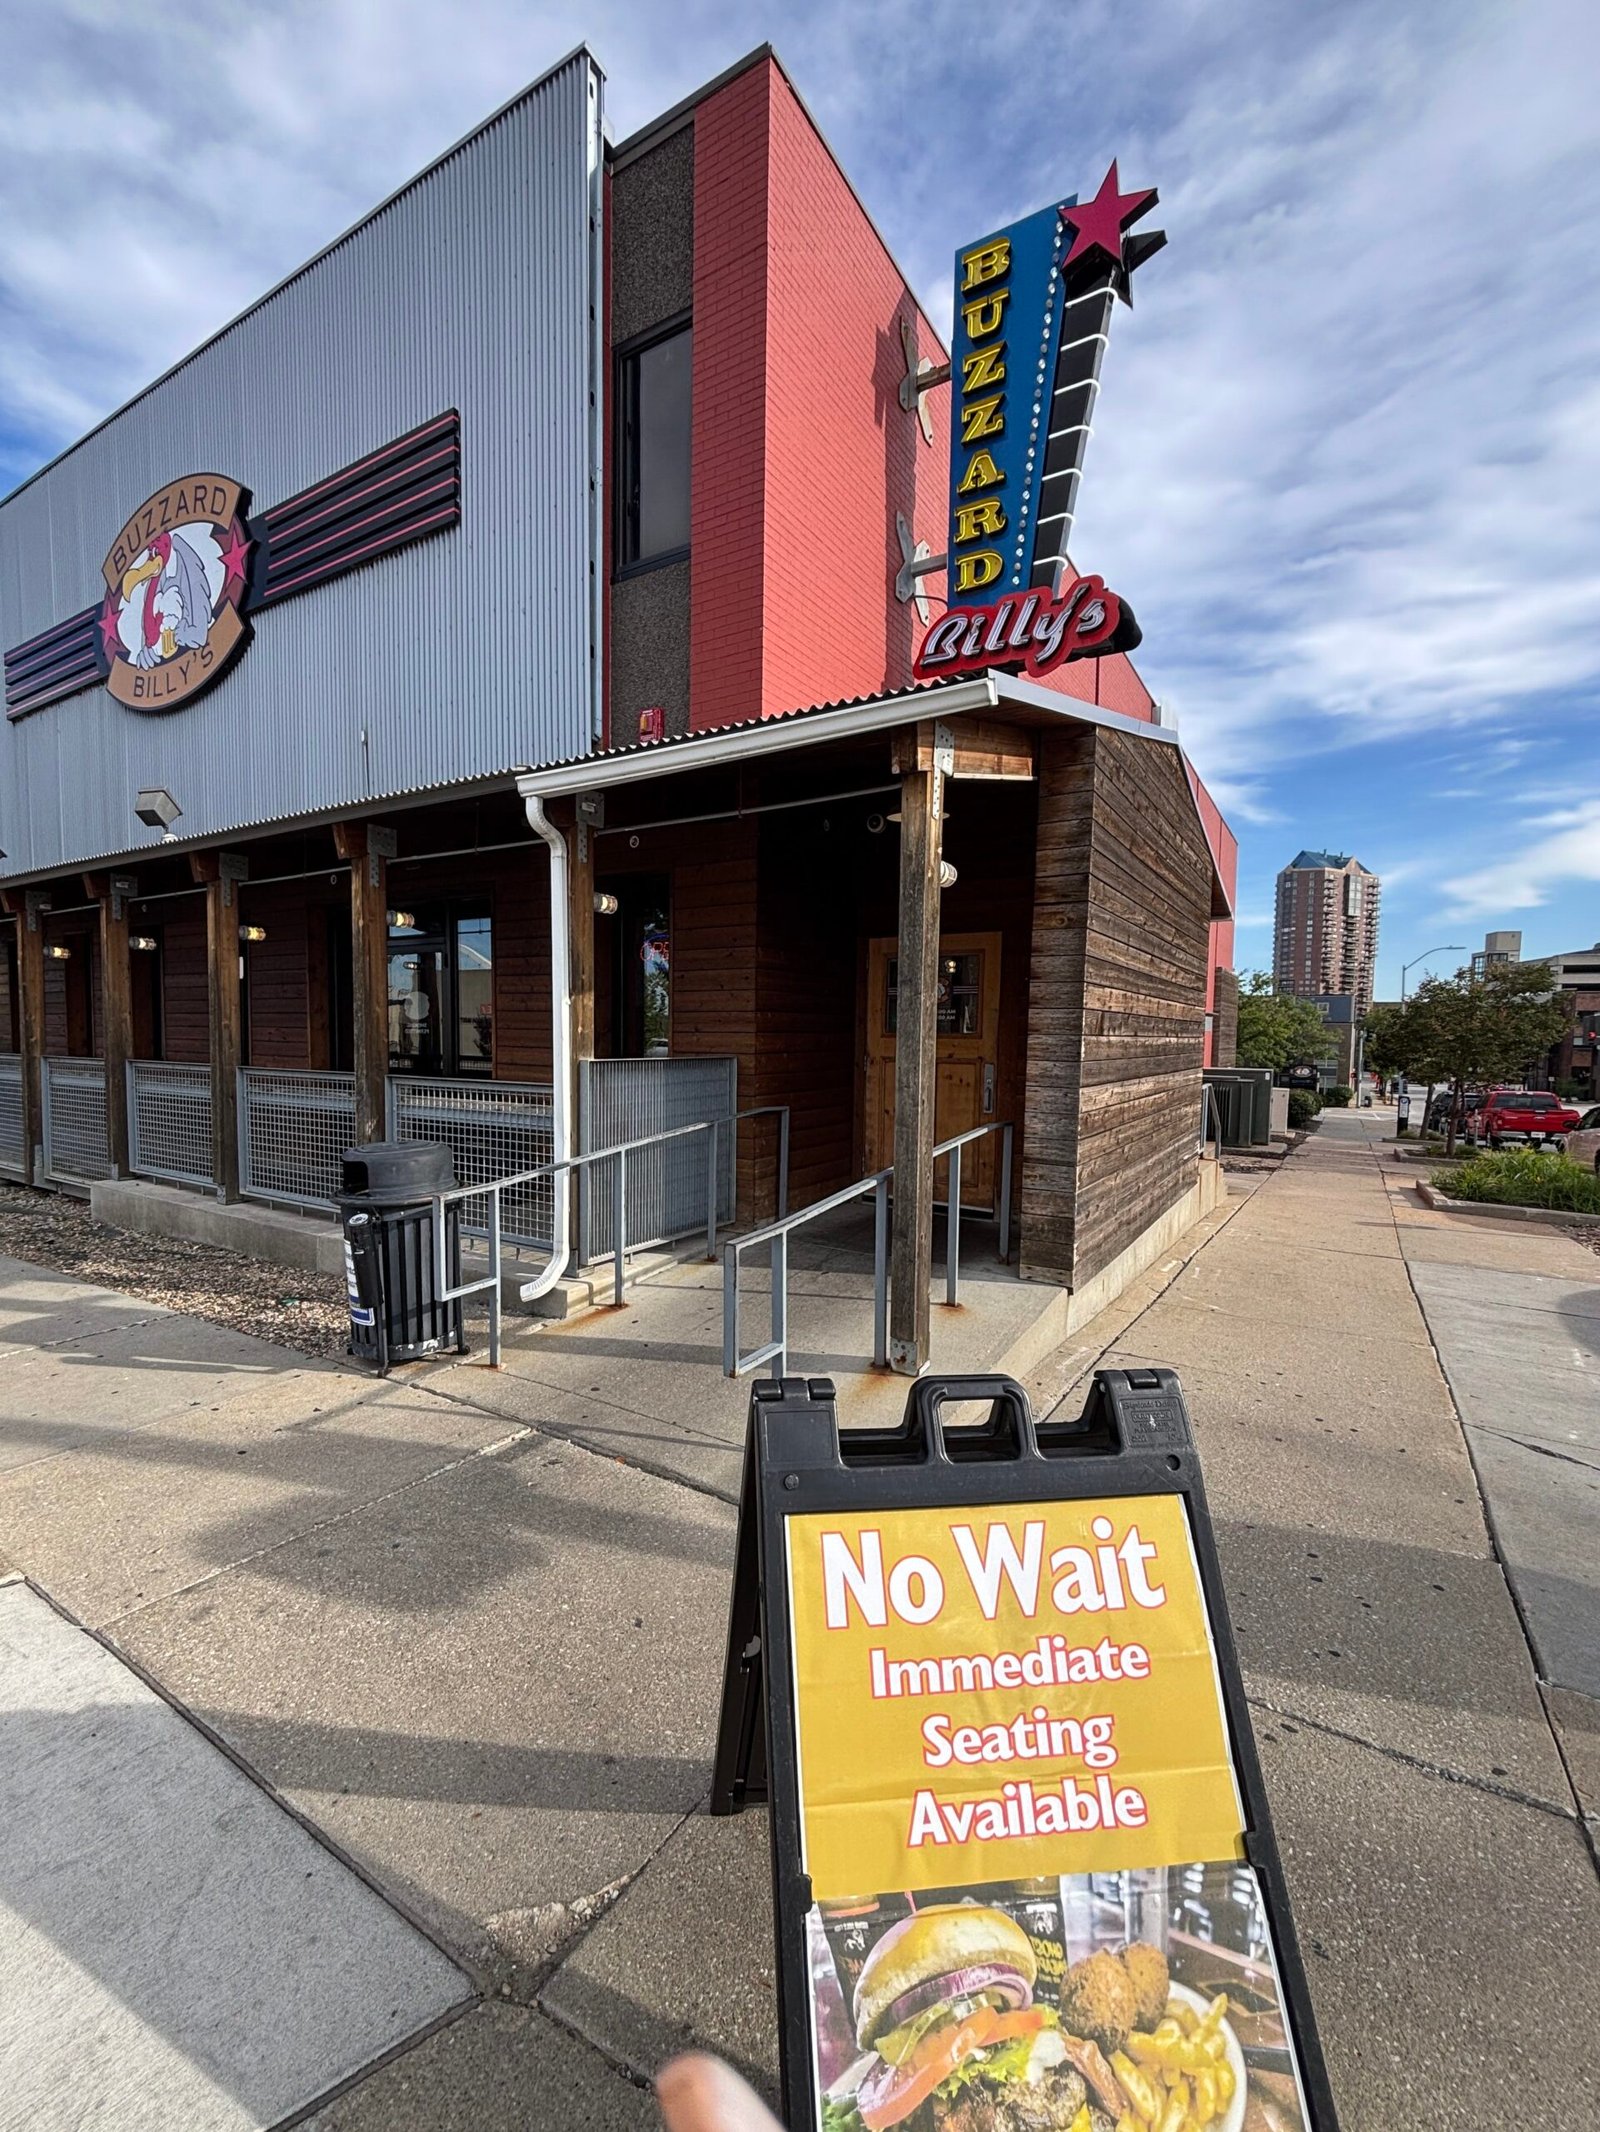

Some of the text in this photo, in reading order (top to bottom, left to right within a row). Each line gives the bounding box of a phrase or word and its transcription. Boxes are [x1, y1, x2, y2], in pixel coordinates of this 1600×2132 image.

[953, 236, 1011, 592] BUZZARD
[112, 484, 228, 575] BUZZARD
[920, 583, 1106, 663] Billy's
[133, 641, 214, 698] BILLY'S
[820, 1515, 1167, 1629] No Wait
[869, 1634, 1151, 1699] Immediate
[921, 1705, 1119, 1769] Seating
[907, 1773, 1149, 1848] Available
